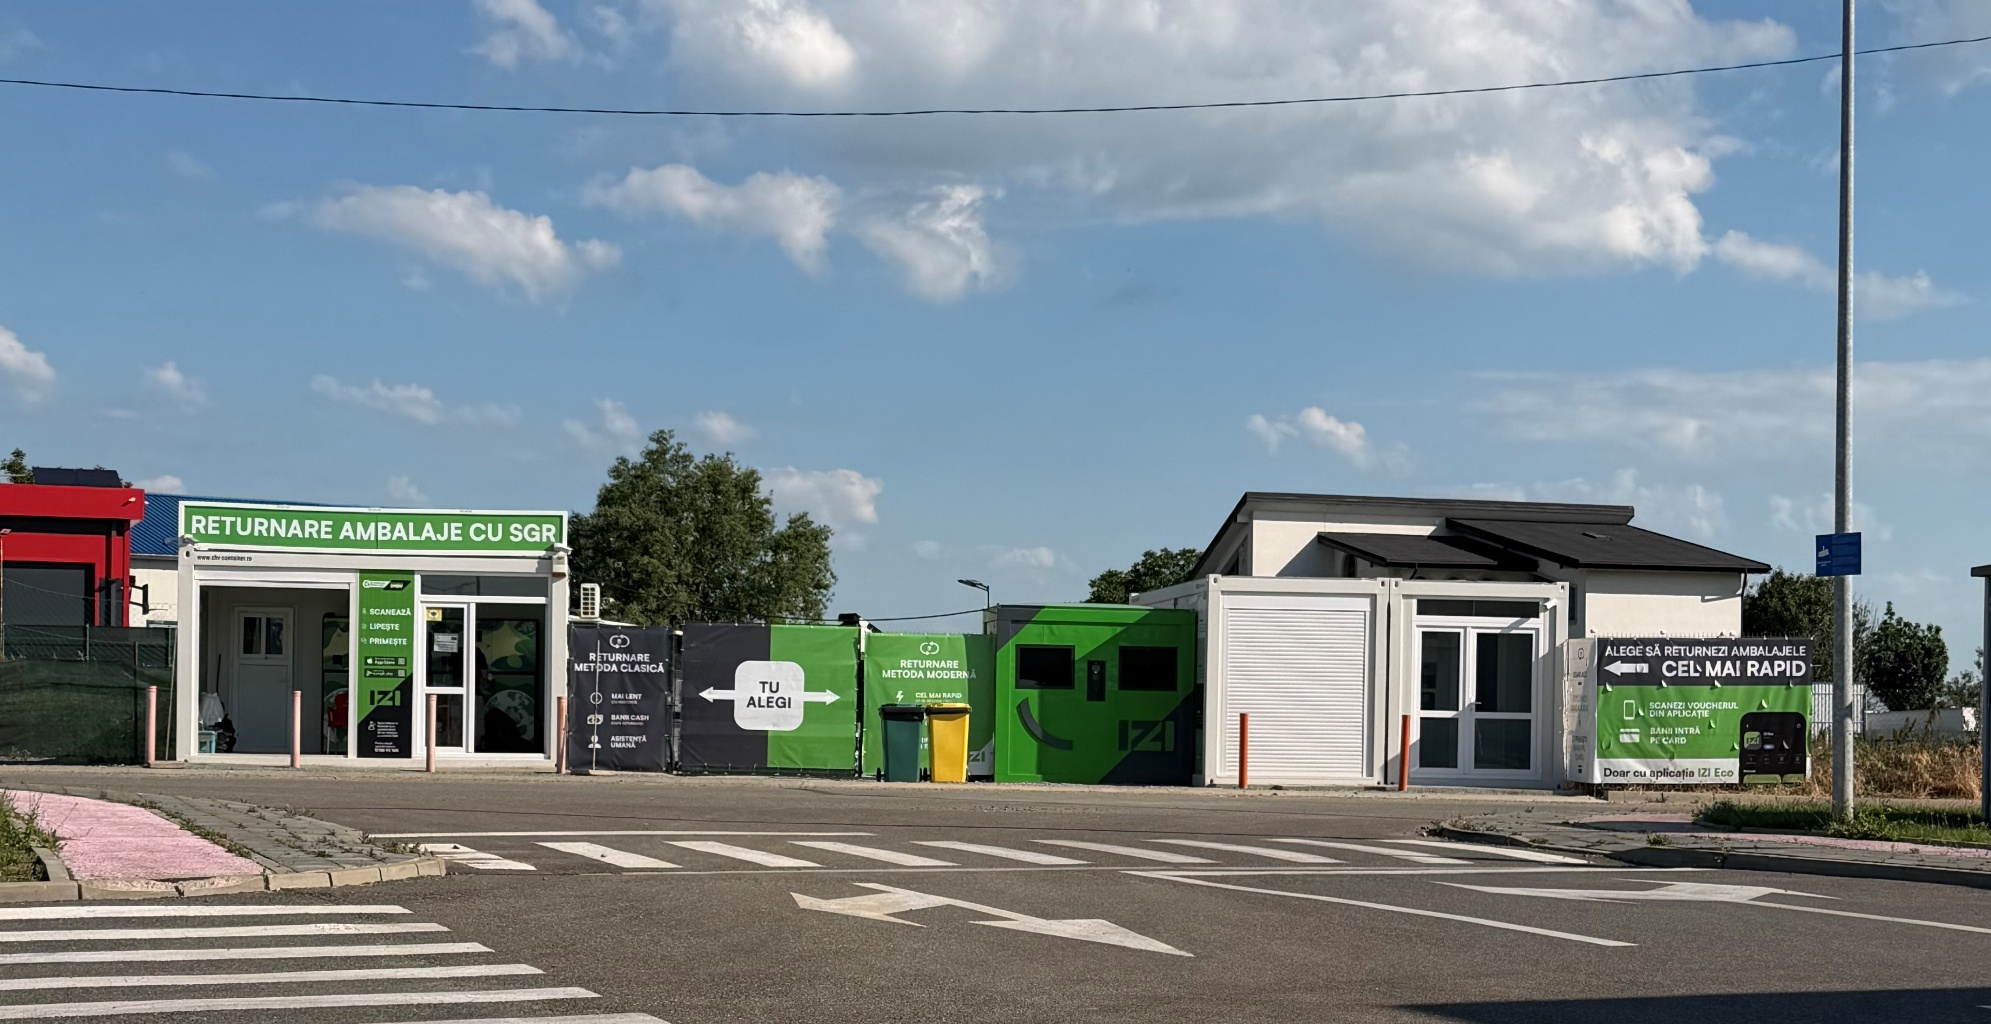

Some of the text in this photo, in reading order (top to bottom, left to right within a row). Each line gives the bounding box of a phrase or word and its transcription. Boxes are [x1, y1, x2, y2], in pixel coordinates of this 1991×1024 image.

[191, 515, 556, 543] RETURNARE AMBALAJE CU SGR
[369, 608, 411, 616] SCANEAZĂ
[369, 623, 400, 631] LIPEȘTE
[369, 638, 407, 646] PRIMEȘTE
[1605, 643, 1806, 657] ALEGE SĂ RETURNEZI AMBALAJELE
[589, 653, 650, 662] RETURNARE
[574, 662, 665, 673] METODA CLASICĂ
[900, 660, 959, 669] RETURNARE
[1661, 660, 1806, 677] CEL MAI RAPID
[882, 669, 976, 679] METODA MODERNĂ
[759, 681, 779, 693] TU
[746, 696, 792, 709] ALEGI
[1666, 710, 1710, 719] APLICAȚIE
[1650, 726, 1701, 735] BANII INTRĂ
[610, 735, 647, 743] ASISTENȚĂ
[1118, 720, 1175, 752] IZI
[1604, 768, 1630, 778] Doar
[1633, 770, 1646, 778] cu
[1650, 768, 1695, 780] aplicația
[1698, 768, 1711, 777] IZI
[1714, 768, 1734, 777] Eco
